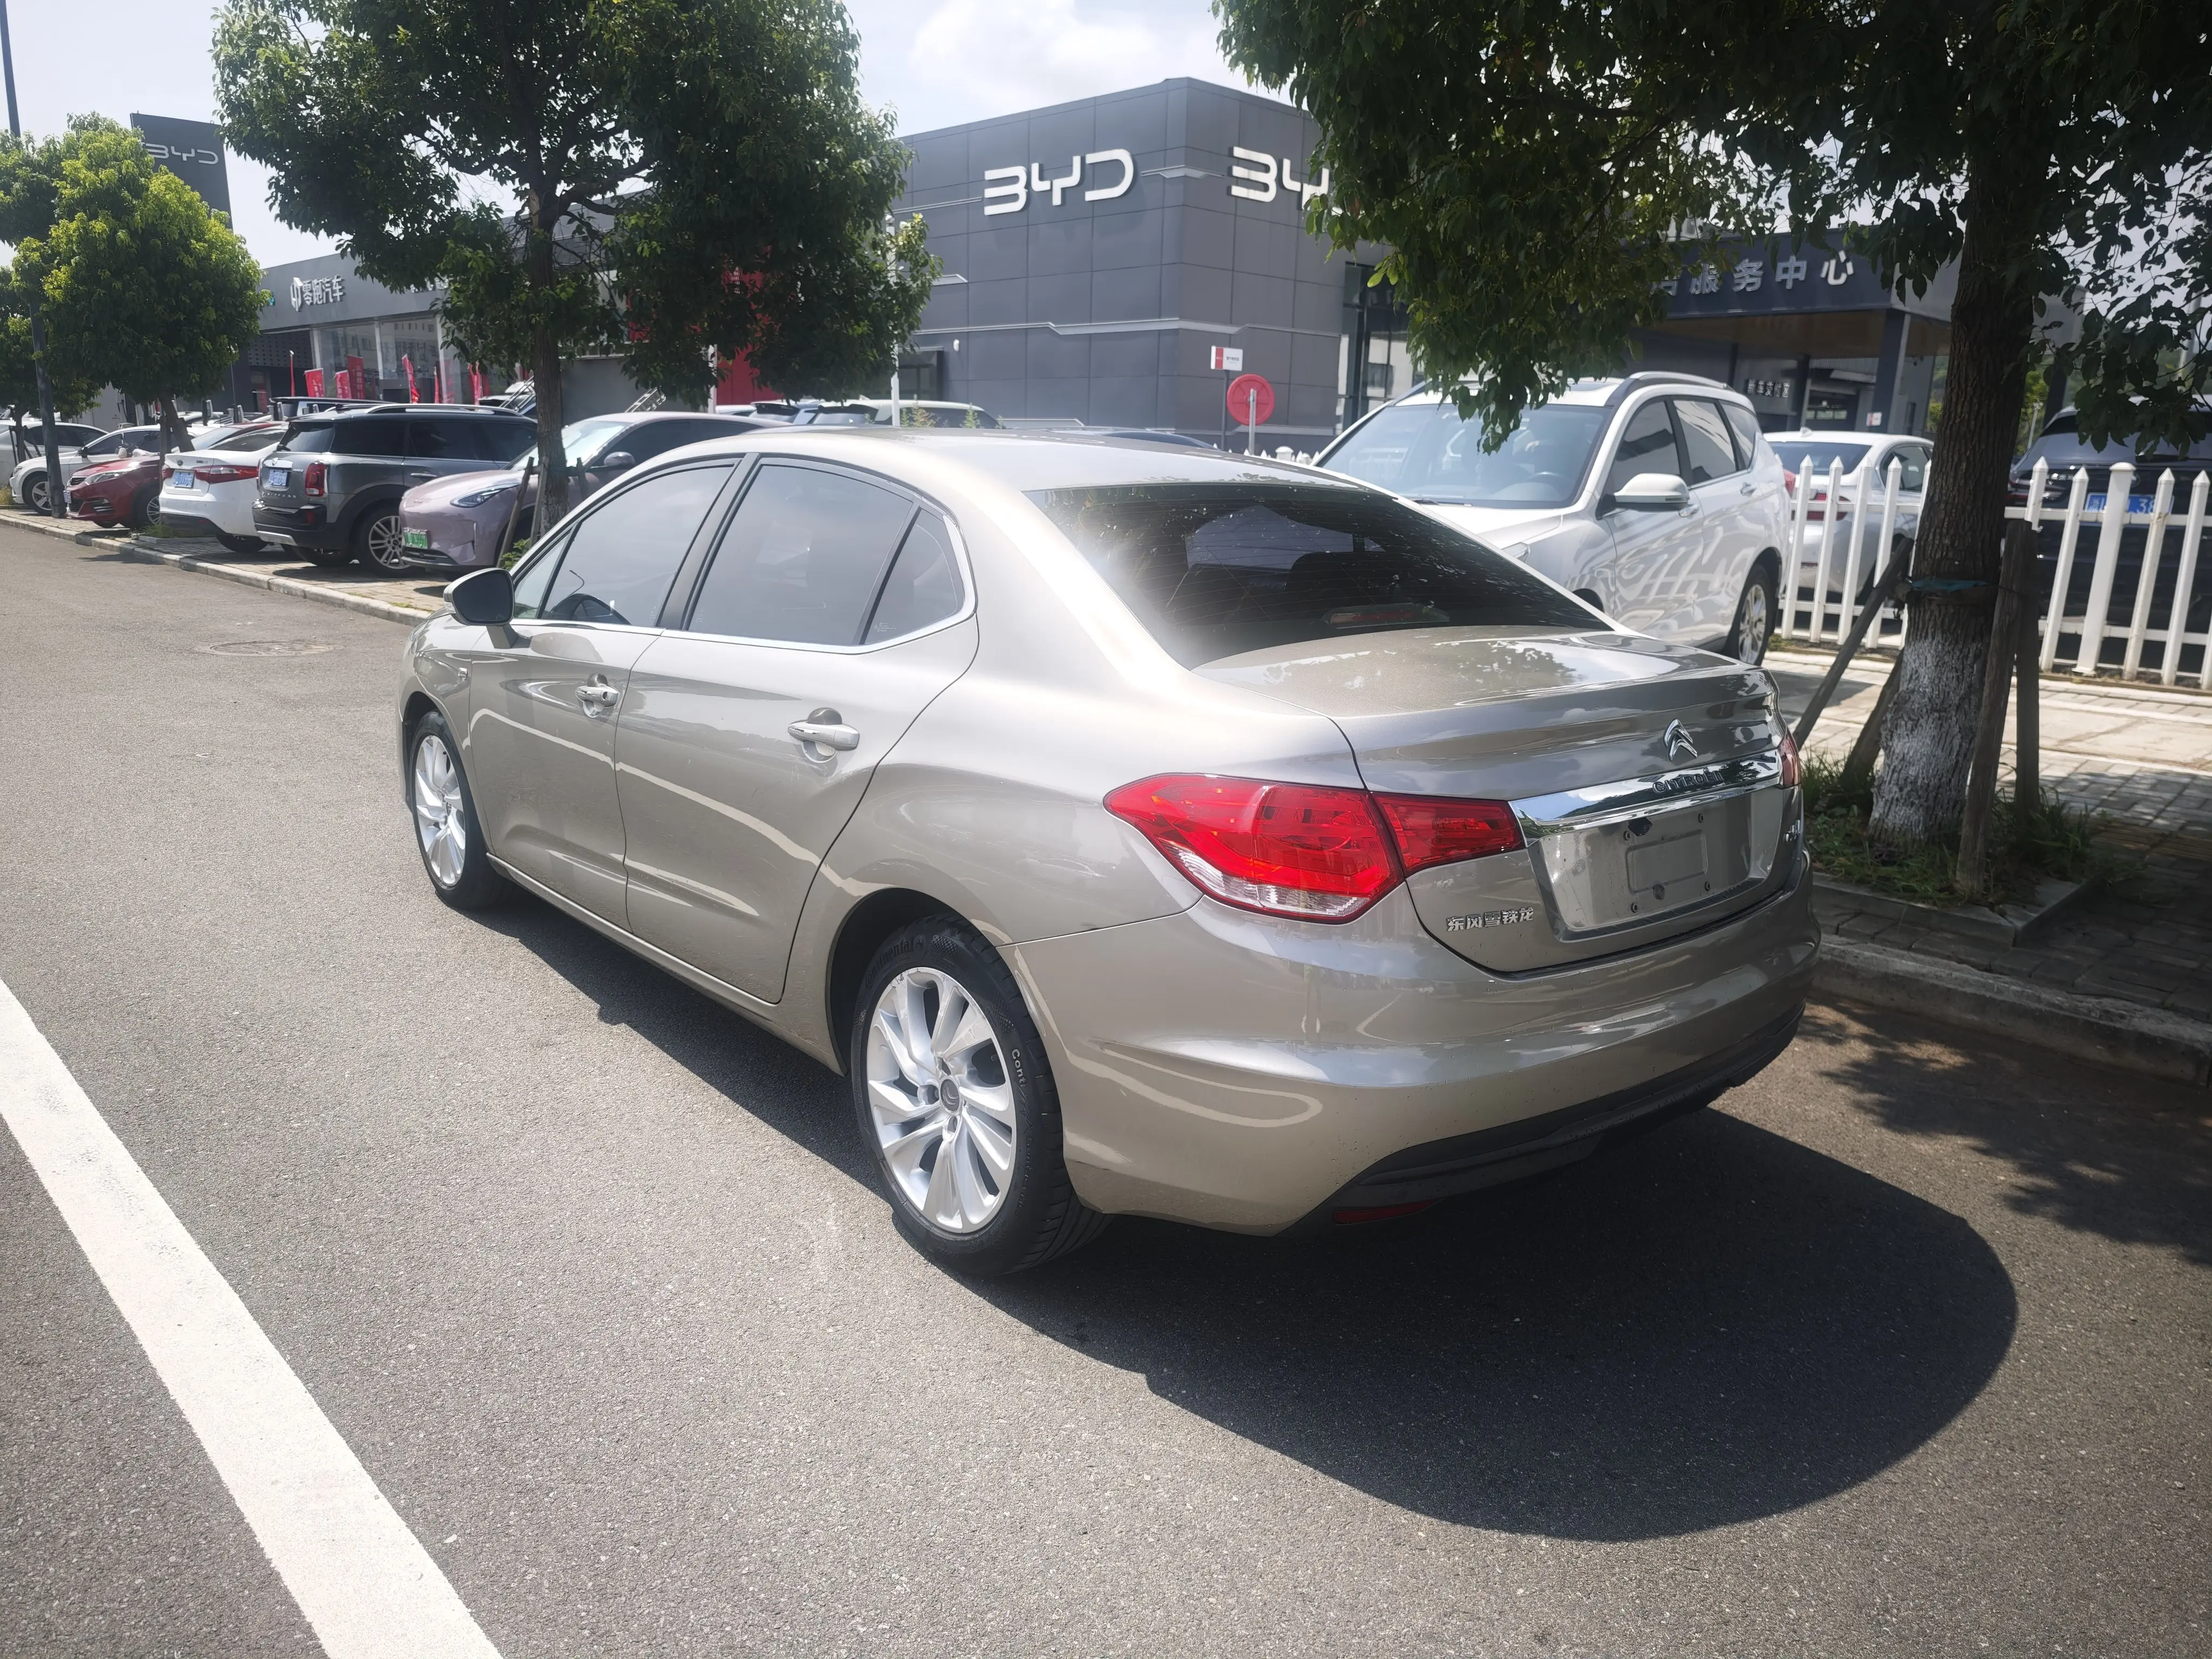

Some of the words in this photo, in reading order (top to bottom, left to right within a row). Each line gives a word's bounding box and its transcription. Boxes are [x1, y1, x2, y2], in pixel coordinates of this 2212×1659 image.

[144, 143, 219, 165] BYD
[984, 149, 1134, 216] BYD
[1231, 146, 1345, 216] BY
[302, 274, 344, 306] 零跑汽车
[1447, 907, 1534, 932] 东风雪铁龙
